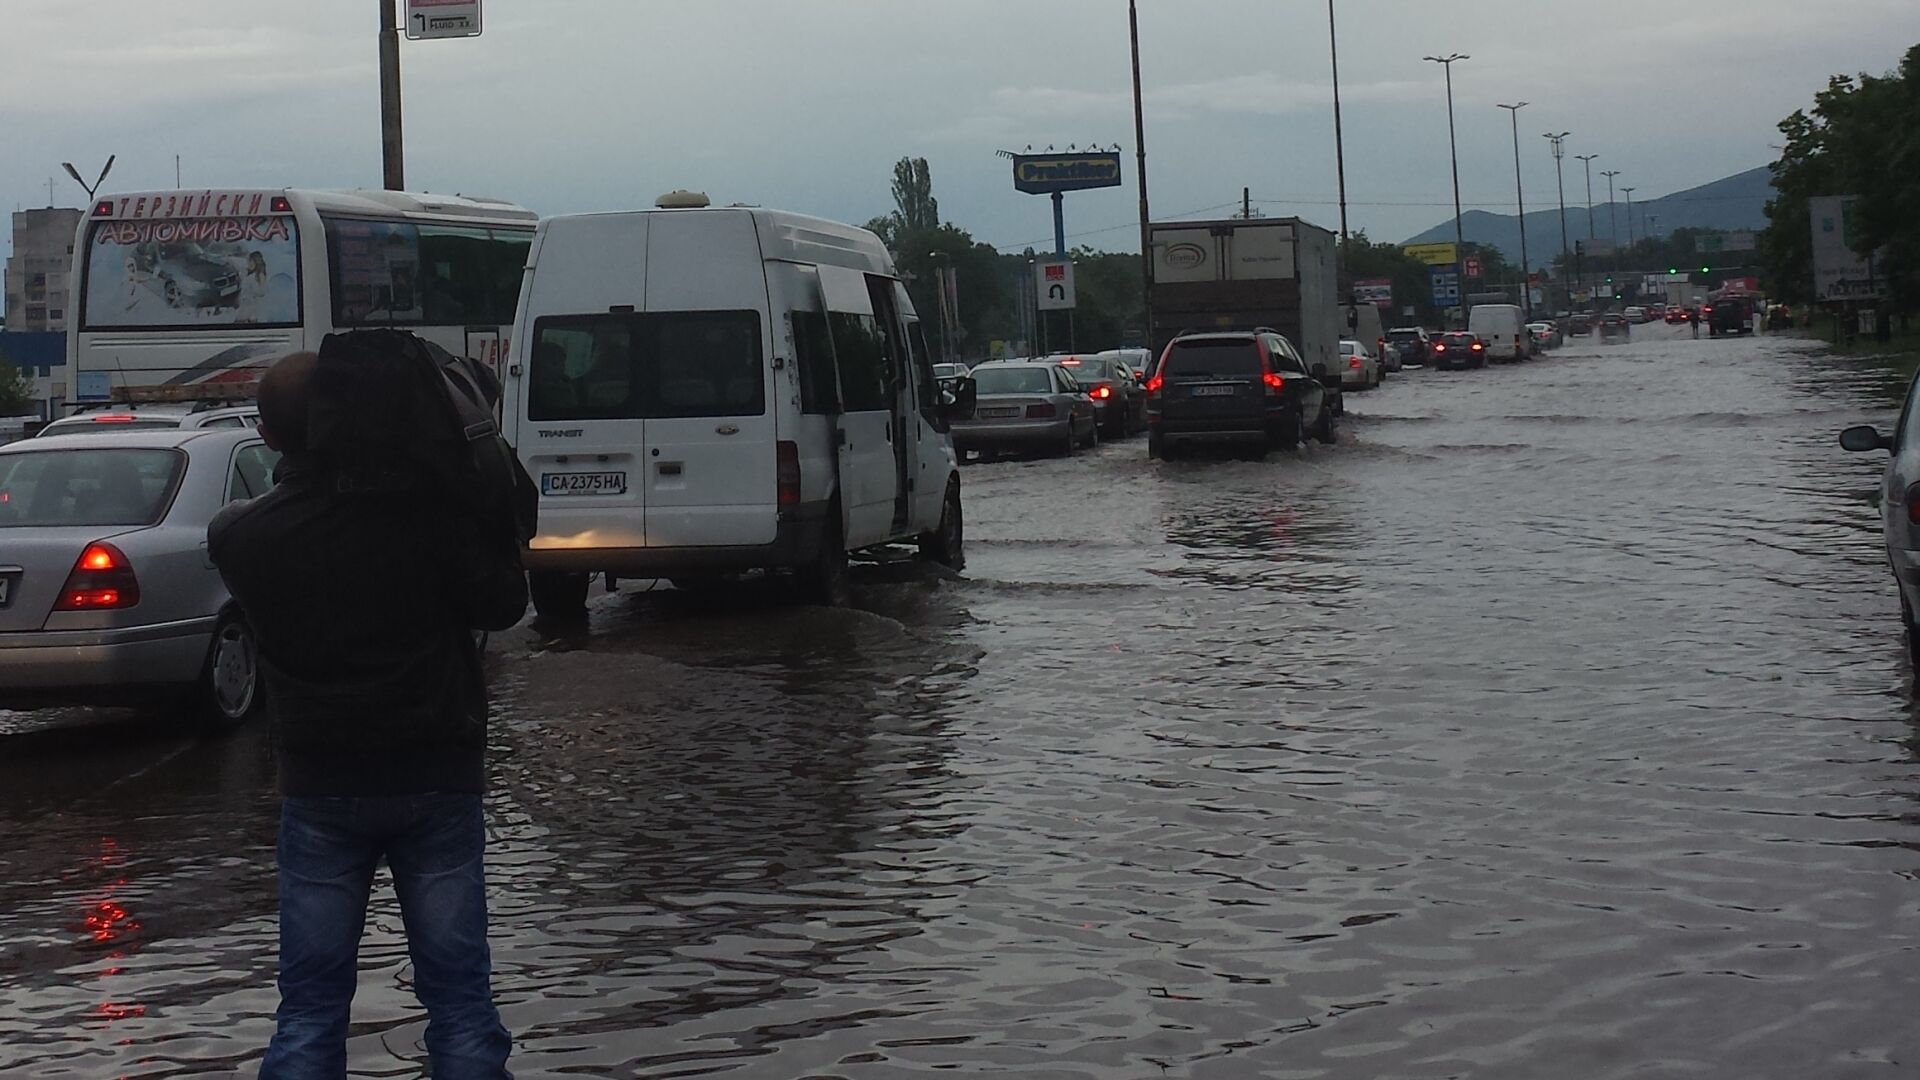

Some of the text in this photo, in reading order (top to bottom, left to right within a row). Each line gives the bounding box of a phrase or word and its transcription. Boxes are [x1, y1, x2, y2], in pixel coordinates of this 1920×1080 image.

[120, 190, 263, 218] ТЕРЗИЙСКИ
[100, 216, 289, 245] АВТОМИВКА
[538, 429, 584, 438] TRANSIT
